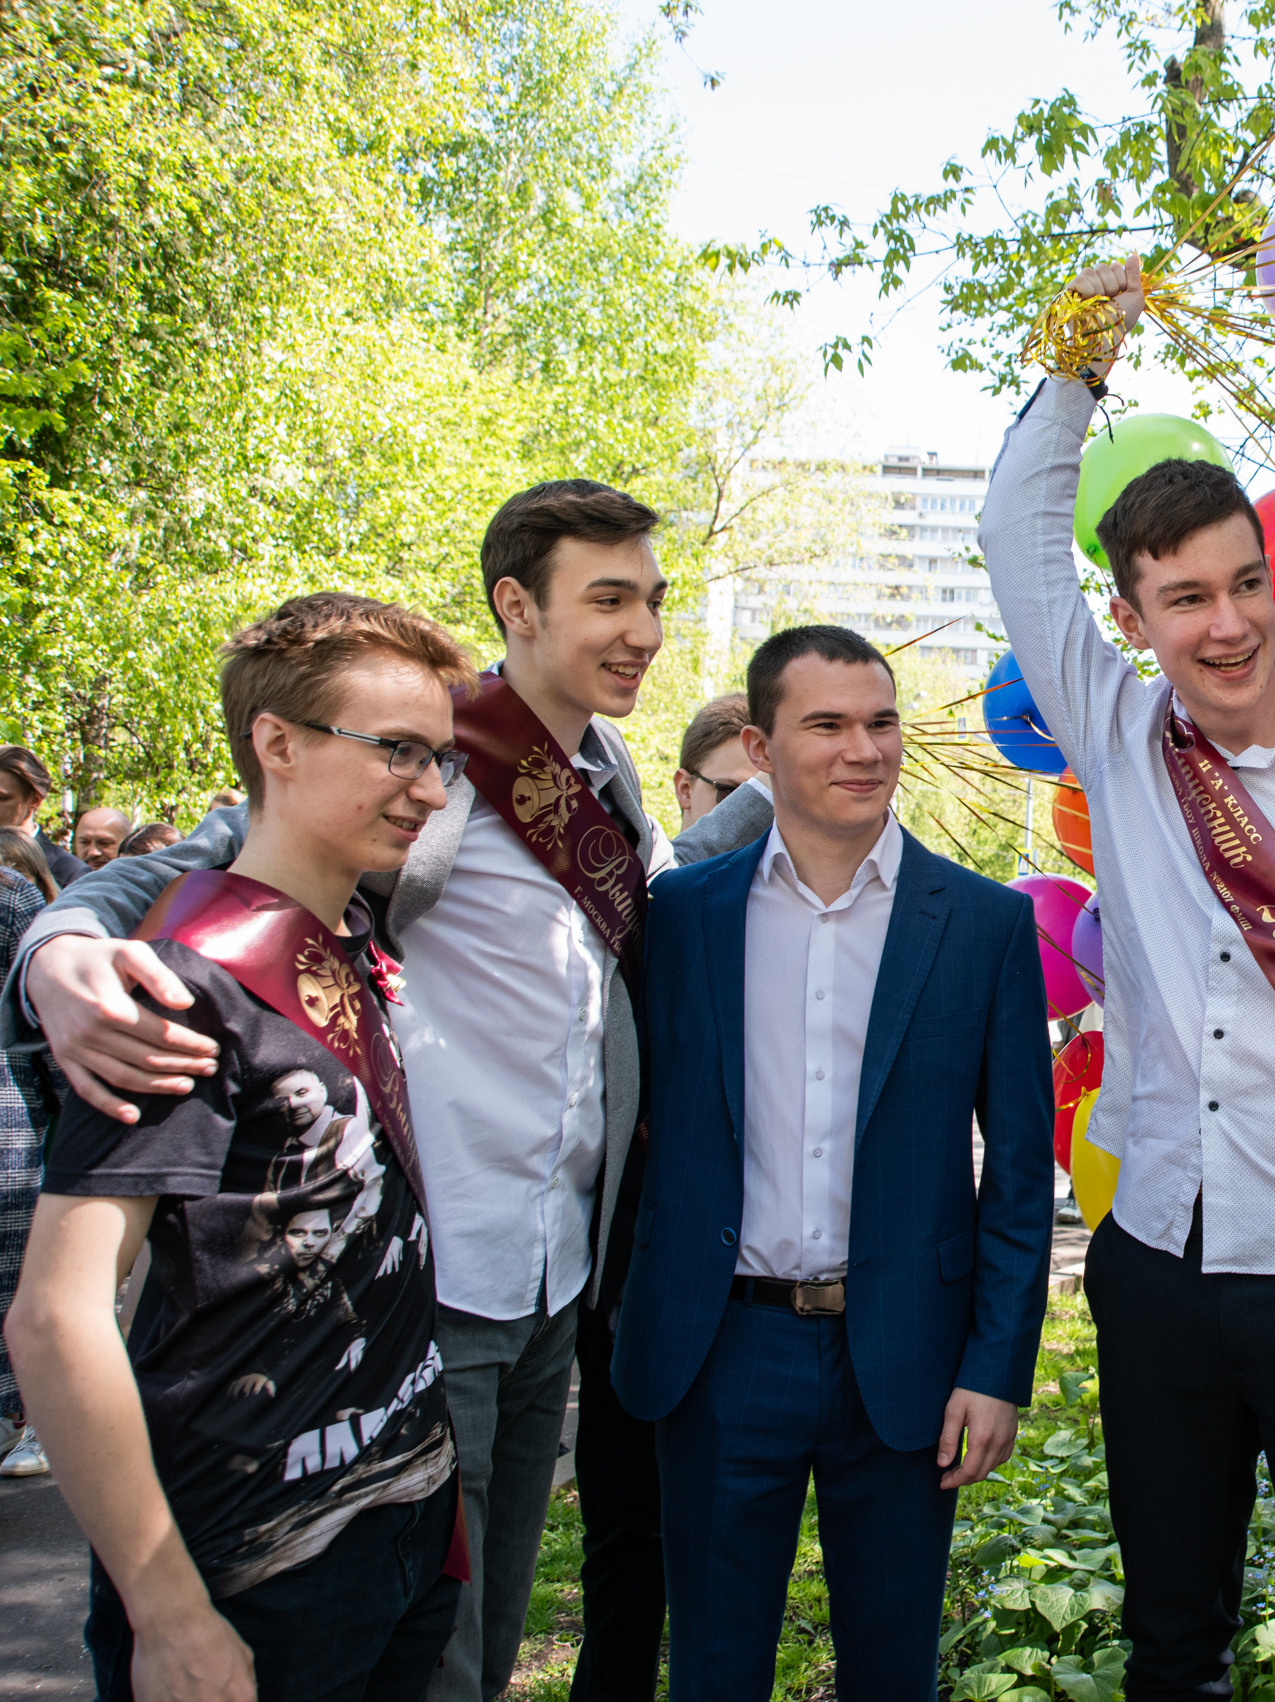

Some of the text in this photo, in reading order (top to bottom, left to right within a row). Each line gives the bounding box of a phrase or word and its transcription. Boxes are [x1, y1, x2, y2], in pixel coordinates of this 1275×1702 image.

[1198, 760, 1212, 772] 11
[1224, 795, 1262, 844] КЛАСС
[581, 896, 611, 938] МОСКВА
[1192, 827, 1211, 871] ШКОЛА
[1210, 871, 1234, 902] №2107
[1230, 904, 1252, 931] ФМШ
